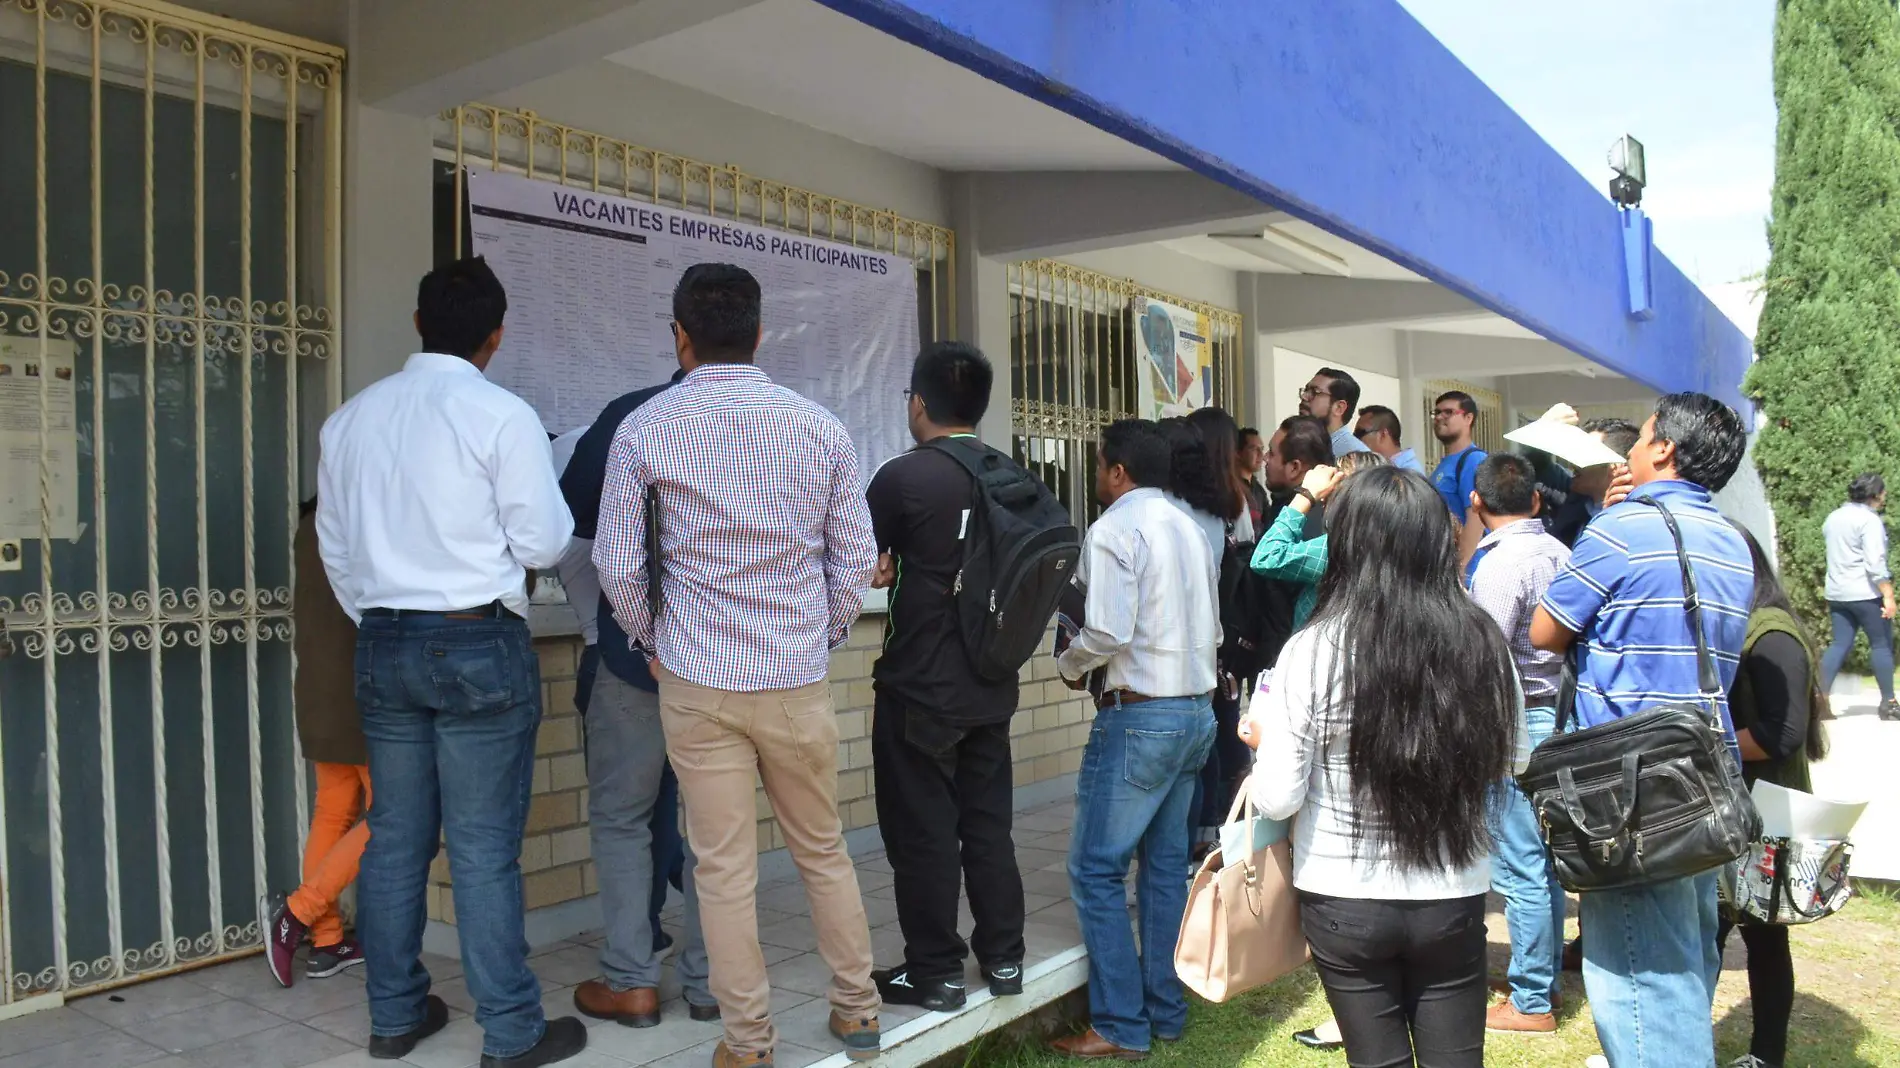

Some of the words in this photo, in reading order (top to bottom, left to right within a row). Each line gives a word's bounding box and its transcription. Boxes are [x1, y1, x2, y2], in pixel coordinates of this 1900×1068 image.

[554, 191, 663, 232] VACANTES
[669, 216, 766, 252] EMPRESAS
[770, 240, 888, 275] PARTICIPANTES
